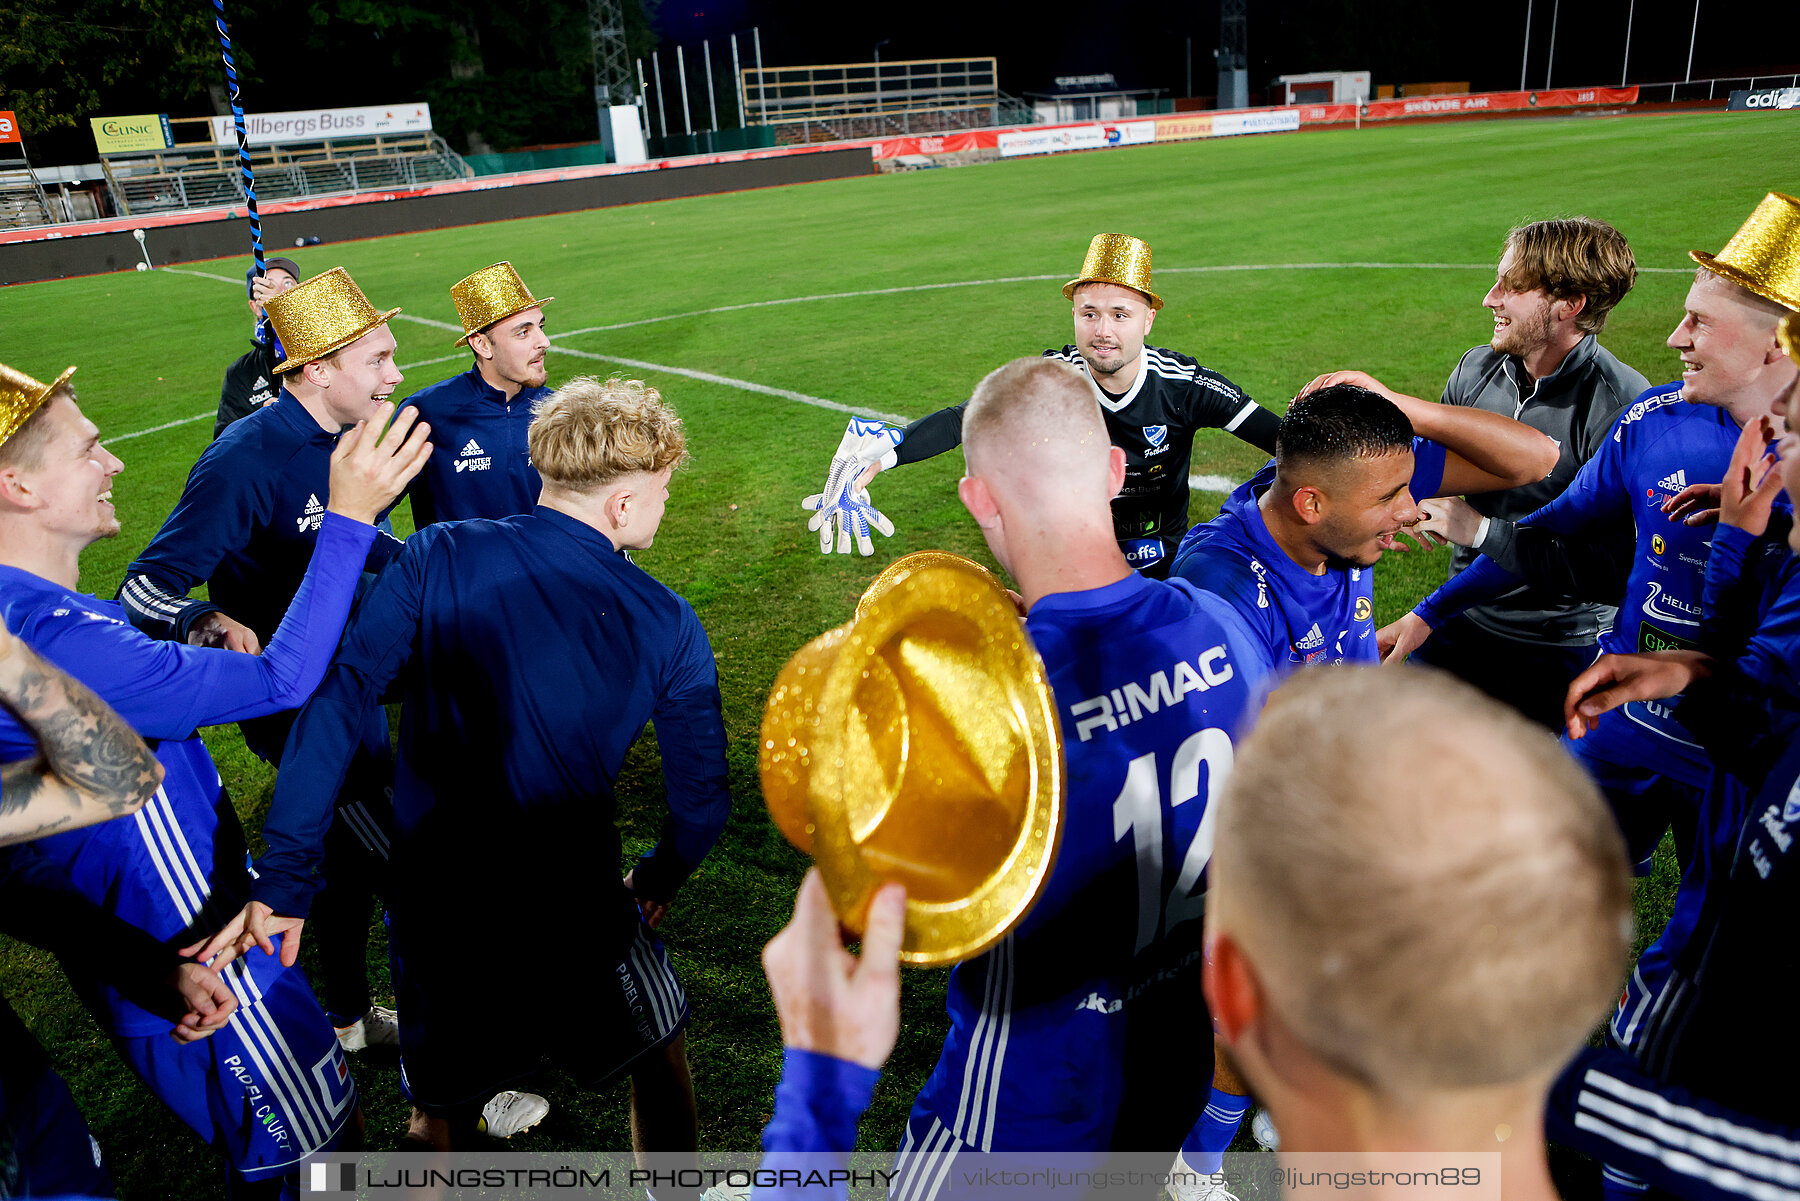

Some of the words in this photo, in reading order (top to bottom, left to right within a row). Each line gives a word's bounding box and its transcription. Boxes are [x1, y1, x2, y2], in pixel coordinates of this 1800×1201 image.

[319, 113, 365, 130] Buss
[460, 448, 485, 457] adidas
[1144, 443, 1170, 459] Fotboll
[468, 456, 492, 465] INTER
[468, 464, 491, 472] SPORT
[304, 505, 325, 515] adidas
[310, 512, 326, 523] INTE
[1126, 544, 1158, 561] offs
[1661, 593, 1704, 616] HELLB
[1295, 636, 1326, 650] adidas
[1113, 727, 1235, 958] 12
[224, 1055, 263, 1106] PADEL
